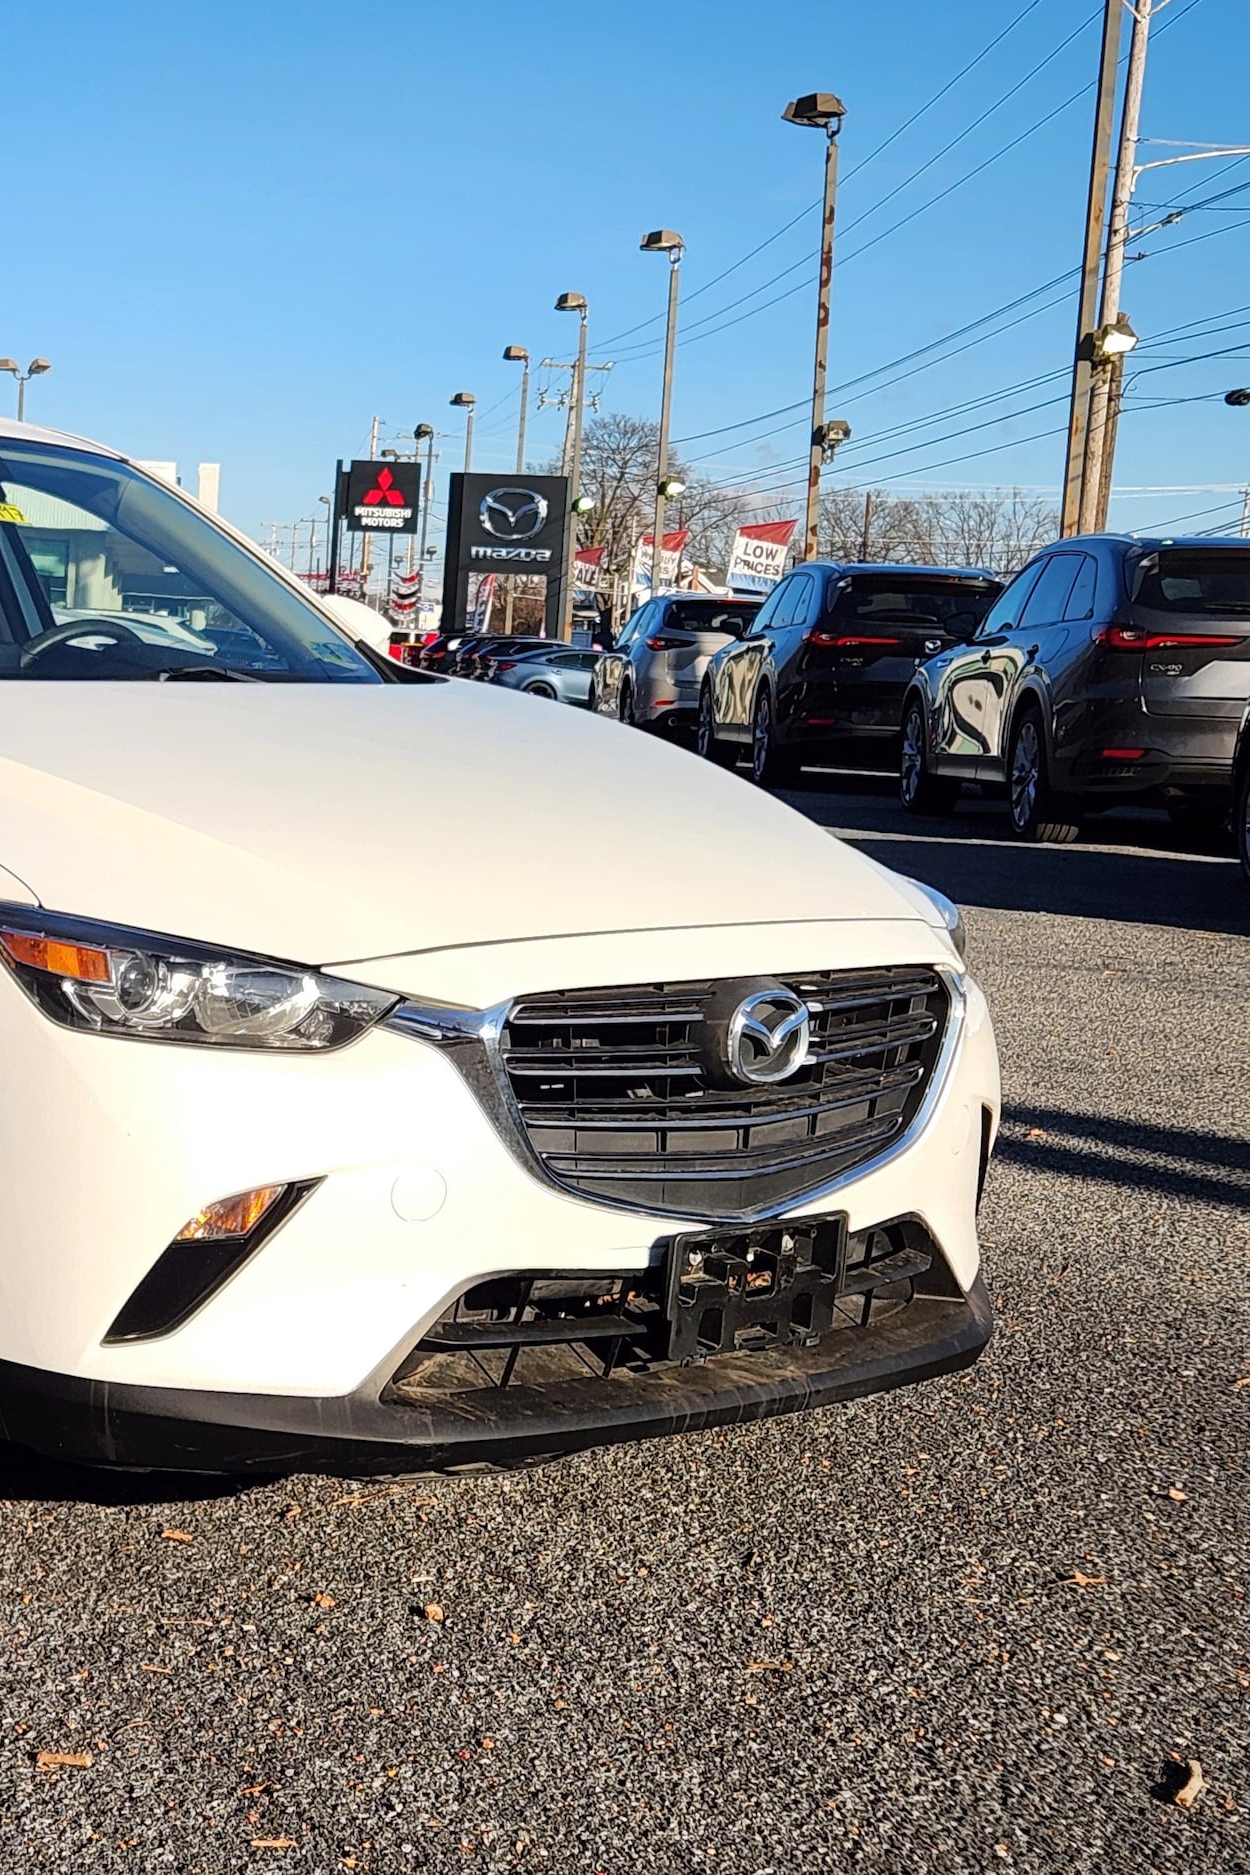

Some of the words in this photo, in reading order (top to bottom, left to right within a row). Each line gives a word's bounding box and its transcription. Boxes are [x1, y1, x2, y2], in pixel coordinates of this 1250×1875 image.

[354, 506, 412, 518] MITSUBISHI
[361, 517, 404, 527] MOTORS
[743, 541, 778, 561] LOW
[734, 556, 781, 576] PRICES
